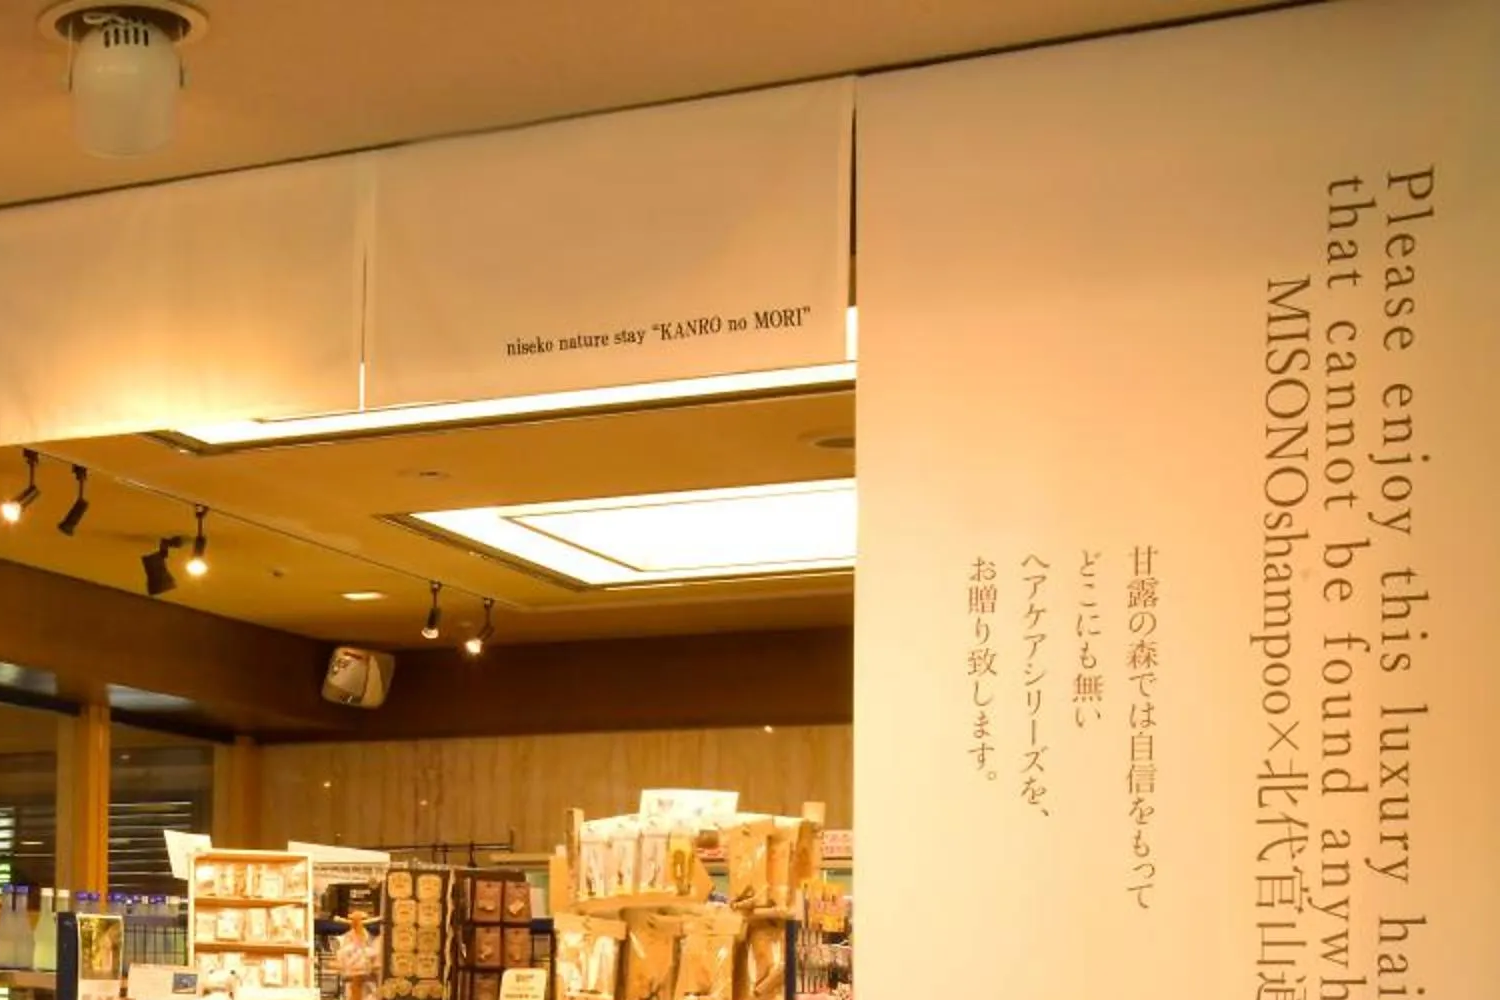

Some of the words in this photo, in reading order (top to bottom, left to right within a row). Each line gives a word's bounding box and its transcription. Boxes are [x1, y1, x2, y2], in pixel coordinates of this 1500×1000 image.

[1327, 174, 1377, 289] that
[1384, 165, 1435, 352] Please
[506, 336, 553, 356] niseko
[559, 332, 609, 351] nature
[613, 328, 646, 346] stay
[727, 316, 747, 331] no
[1323, 319, 1363, 511] cannot
[1368, 382, 1431, 536] enjoy
[1072, 549, 1105, 729] どこにも無い
[1322, 537, 1371, 604] be
[1380, 567, 1430, 673] this
[966, 555, 999, 782] お贈り致します。
[1020, 552, 1052, 818] ヘアケアシリーズを、
[1126, 544, 1160, 910] 甘露の森では自信をもって
[1320, 632, 1371, 796] found
[1364, 704, 1429, 884] luxury
